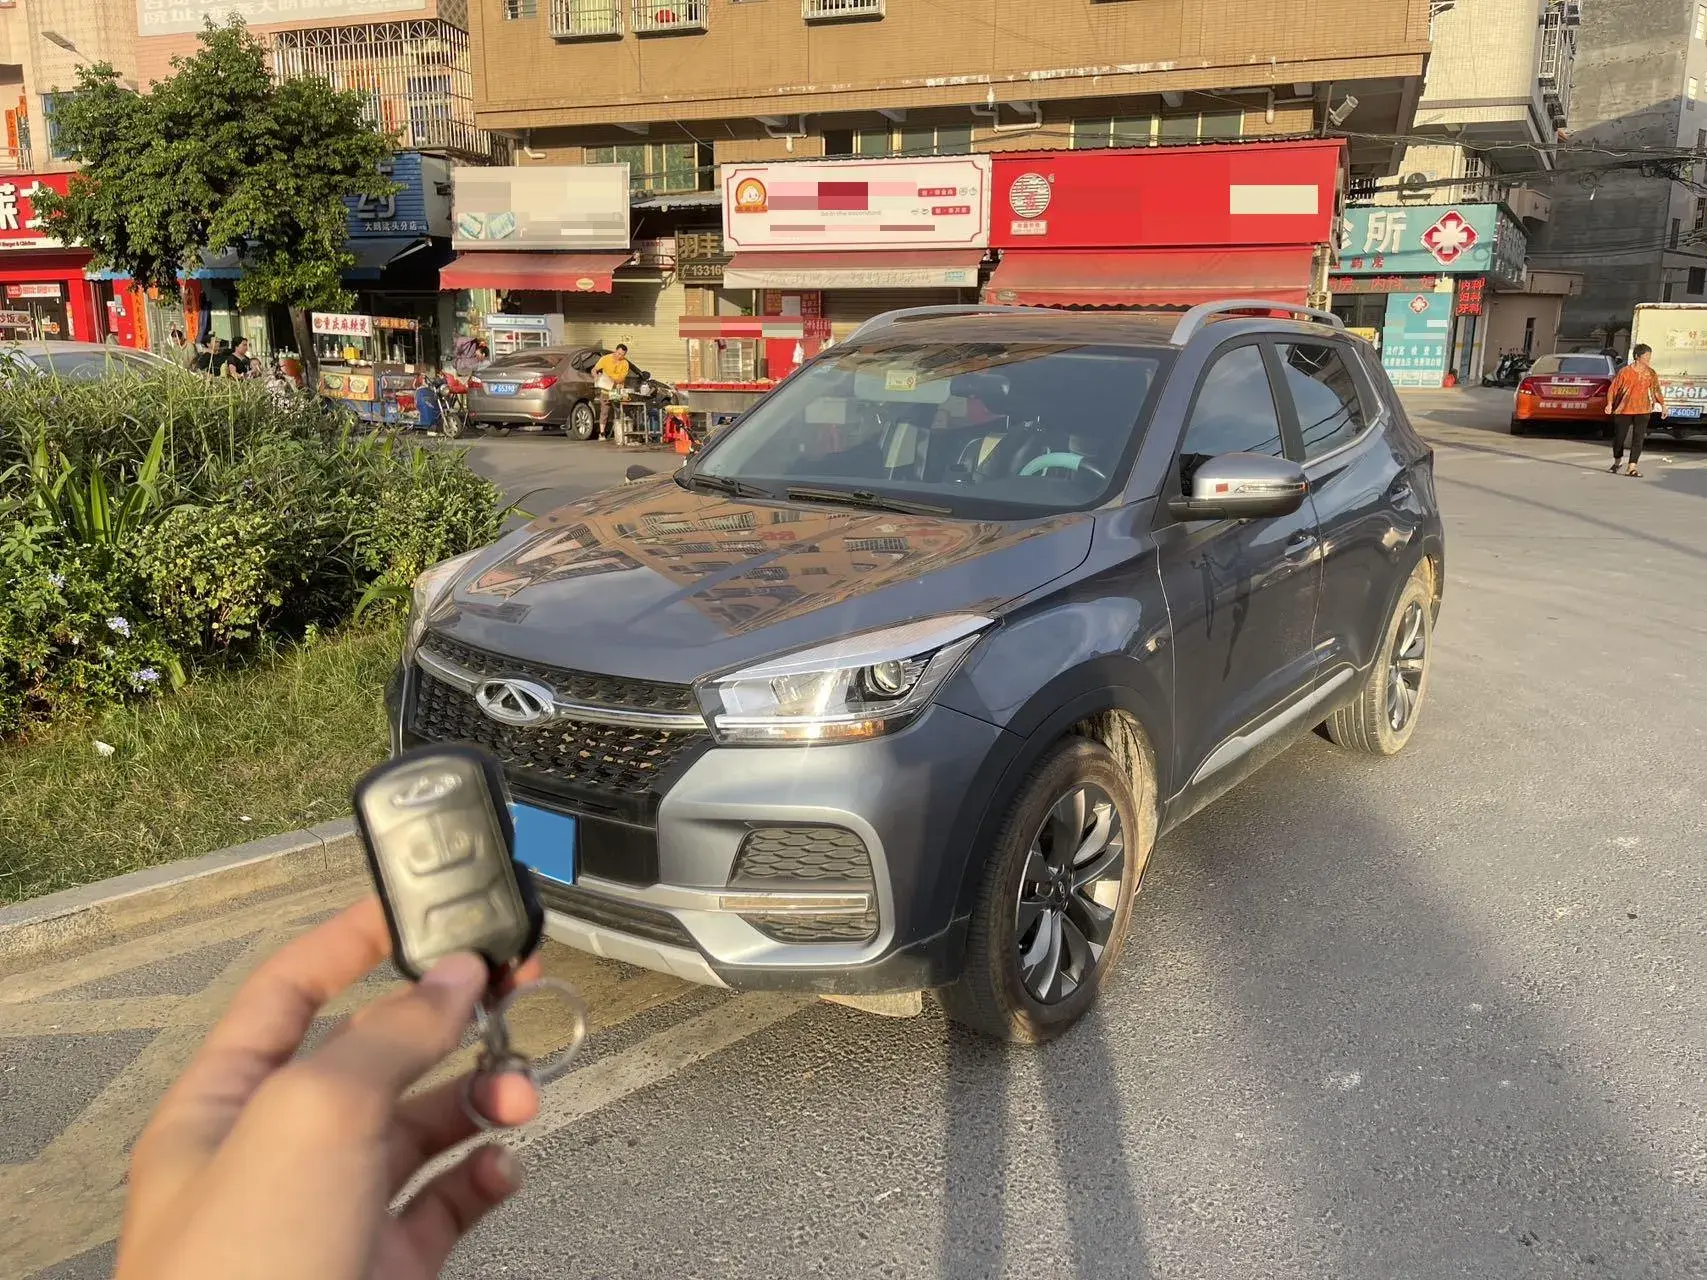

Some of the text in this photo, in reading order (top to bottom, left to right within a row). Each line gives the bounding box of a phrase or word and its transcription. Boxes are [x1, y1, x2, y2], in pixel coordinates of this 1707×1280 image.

[324, 317, 369, 334] 重庆麻辣烫
